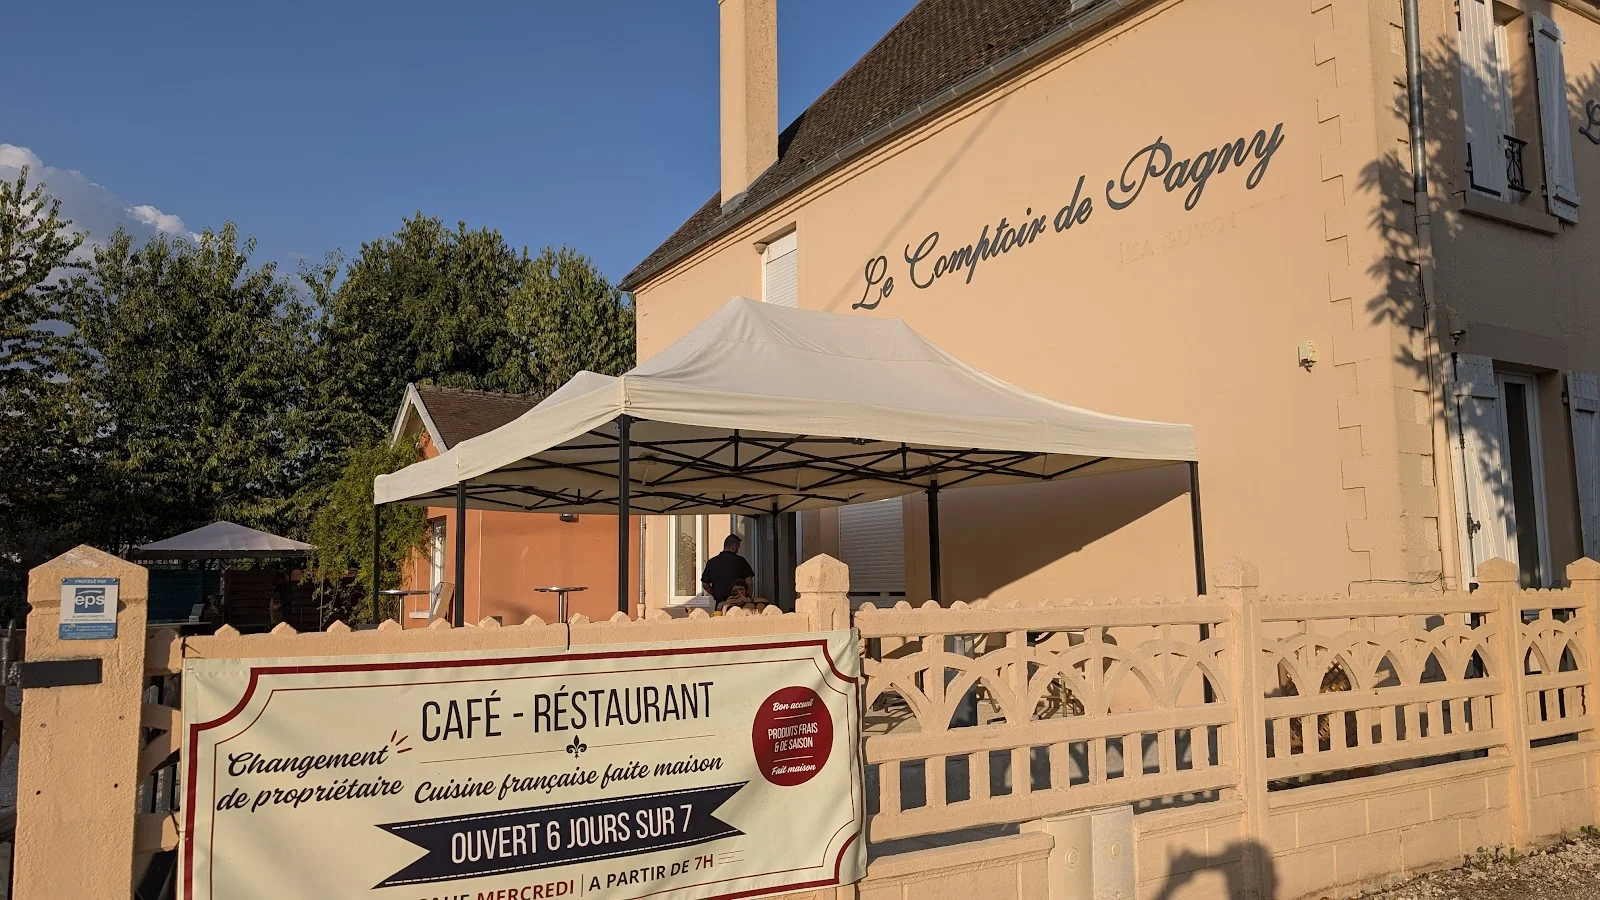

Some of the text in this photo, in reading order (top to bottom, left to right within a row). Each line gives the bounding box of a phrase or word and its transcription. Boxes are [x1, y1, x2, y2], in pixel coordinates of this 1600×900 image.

[852, 255, 894, 310] Le
[904, 206, 1047, 289] Comptoir
[1053, 175, 1093, 233] de
[1105, 123, 1285, 211] Pagny
[75, 595, 105, 608] eps
[421, 690, 502, 742] CAFÉ
[533, 681, 714, 733] RÉSTAURANT
[772, 702, 789, 711] Bon
[767, 722, 818, 740] PRODUITS FRAIS
[774, 737, 813, 752] & DE SAISON
[228, 745, 389, 779] Changement
[414, 755, 724, 803] Cuisine française faite maison
[771, 763, 816, 775] Fait maison
[216, 777, 404, 813] de propriétaire
[451, 804, 693, 864] OUVERT 6 JOURS SUR 7
[588, 876, 602, 892] A
[606, 865, 666, 889] PARTIR
[670, 859, 691, 877] DE
[693, 853, 715, 870] 7H
